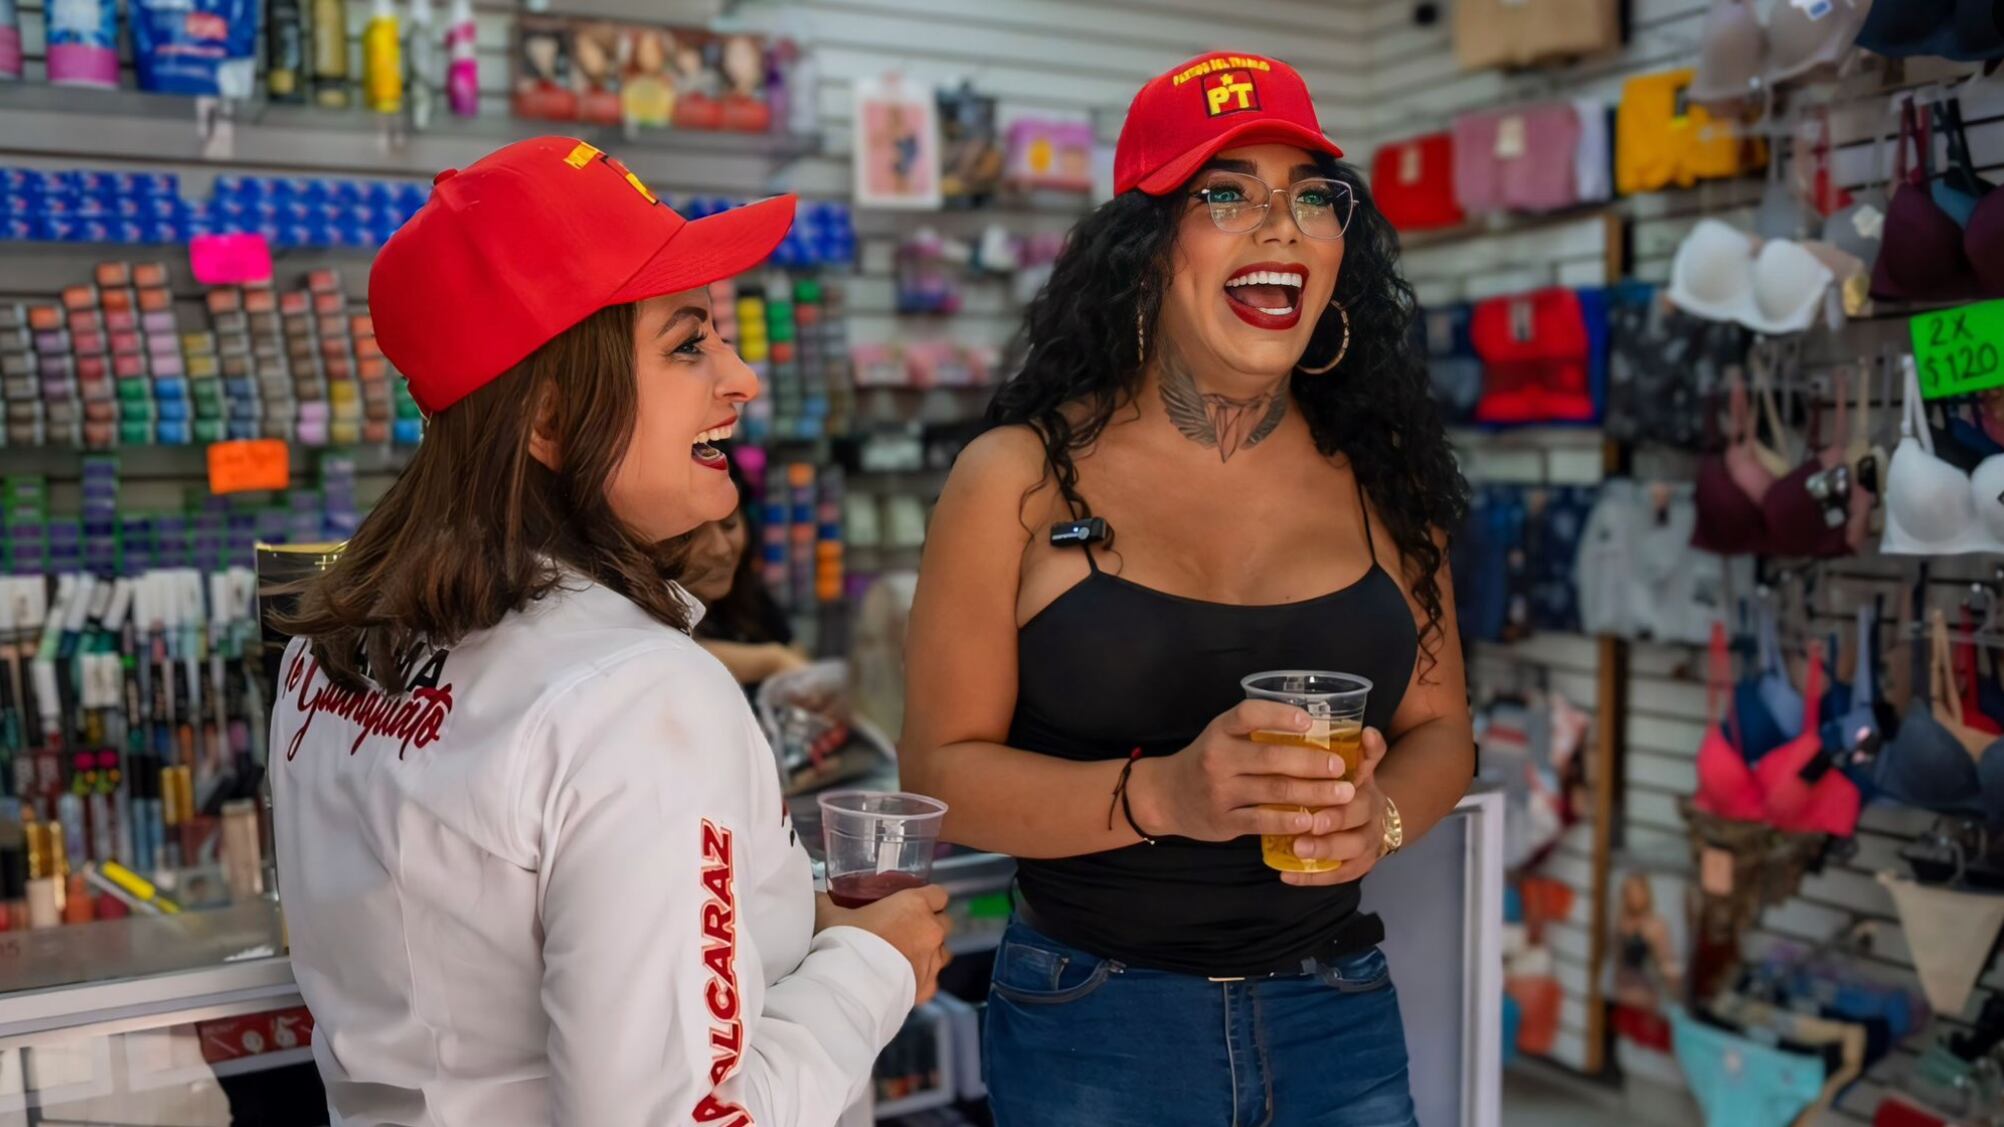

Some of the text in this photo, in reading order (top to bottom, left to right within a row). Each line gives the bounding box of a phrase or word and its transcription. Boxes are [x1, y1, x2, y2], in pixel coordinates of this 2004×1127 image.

[1207, 82, 1254, 115] PT
[1924, 342, 1999, 389] $120
[700, 818, 744, 1087] ALCARAZ
